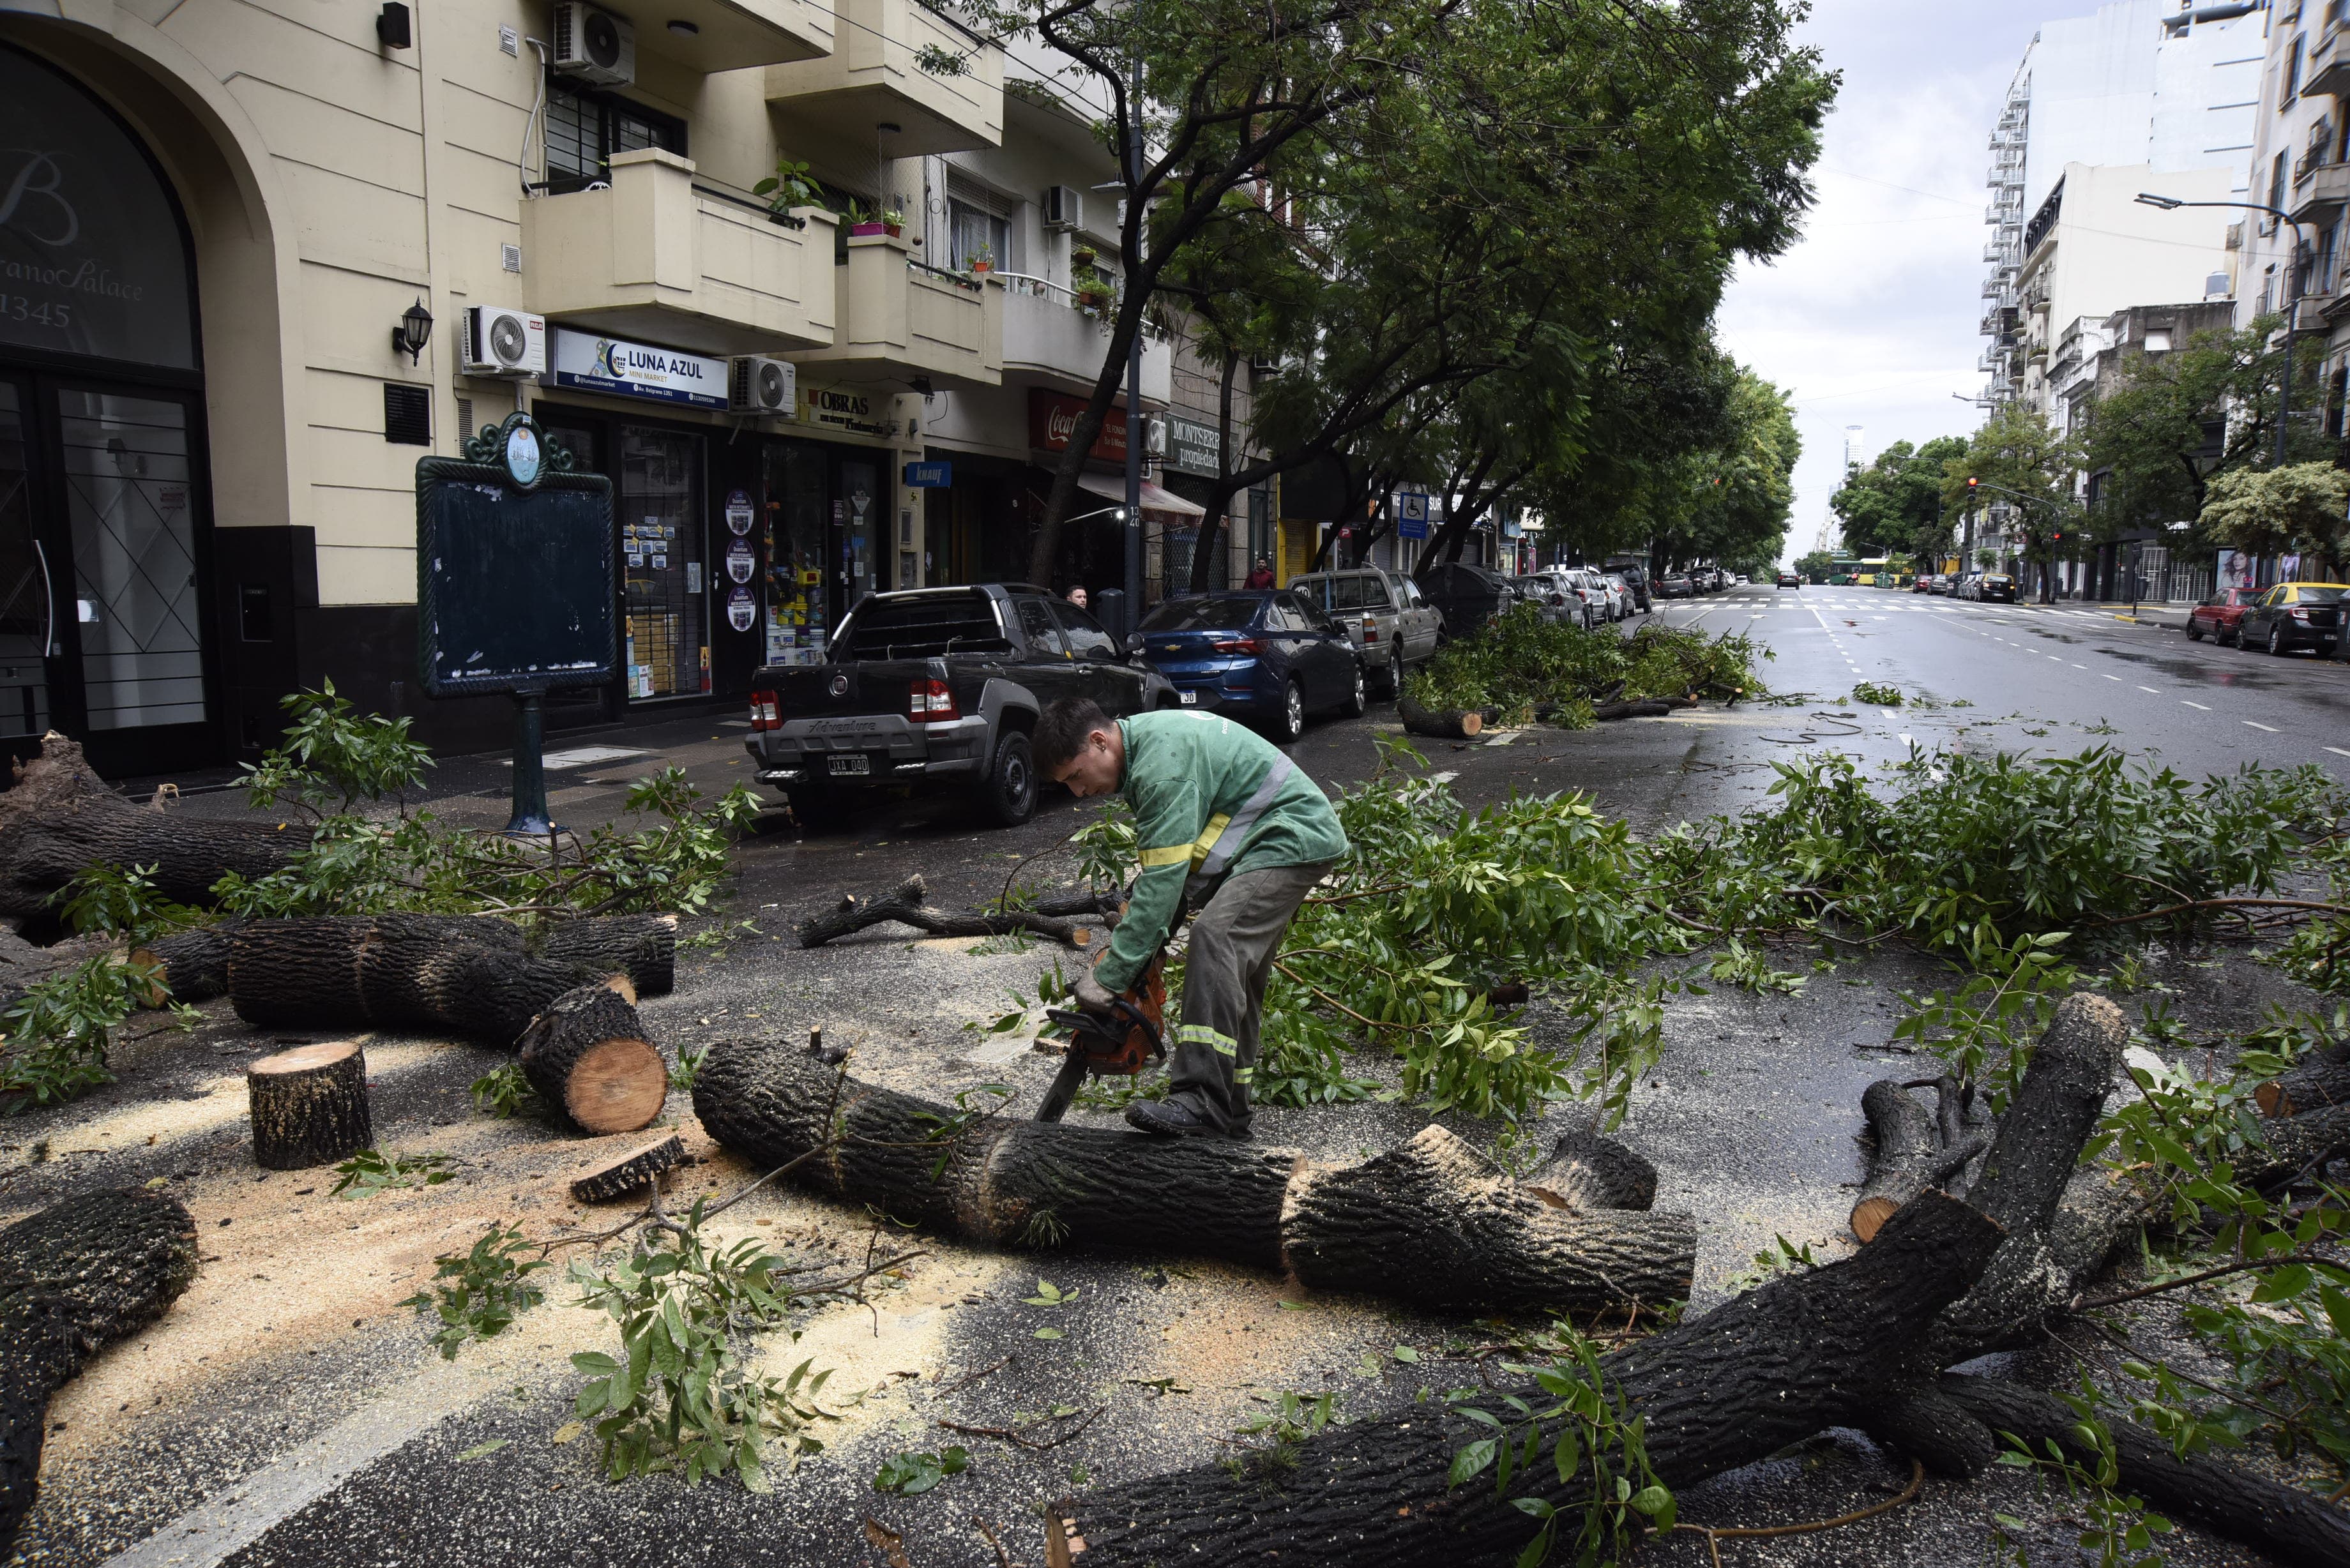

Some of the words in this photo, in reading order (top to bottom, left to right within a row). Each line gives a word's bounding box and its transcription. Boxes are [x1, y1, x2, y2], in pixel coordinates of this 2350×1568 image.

[0, 259, 56, 284] ano
[56, 259, 142, 301] Palace
[0, 294, 70, 328] 1345
[530, 321, 543, 330] RCA
[629, 350, 666, 373] LUNA
[669, 358, 703, 379] AZUL
[629, 370, 642, 379] MINI
[644, 372, 668, 383] MARKET
[821, 391, 868, 415] OBRAS
[1172, 420, 1220, 450] MONTSERR
[1179, 448, 1220, 469] propiedad
[916, 465, 943, 484] KNAUF
[1130, 506, 1139, 516] 13
[1429, 496, 1442, 511] SUR
[1130, 518, 1140, 527] 40
[809, 720, 876, 733] Adventure
[831, 760, 847, 771] JXA
[851, 760, 867, 771] 040
